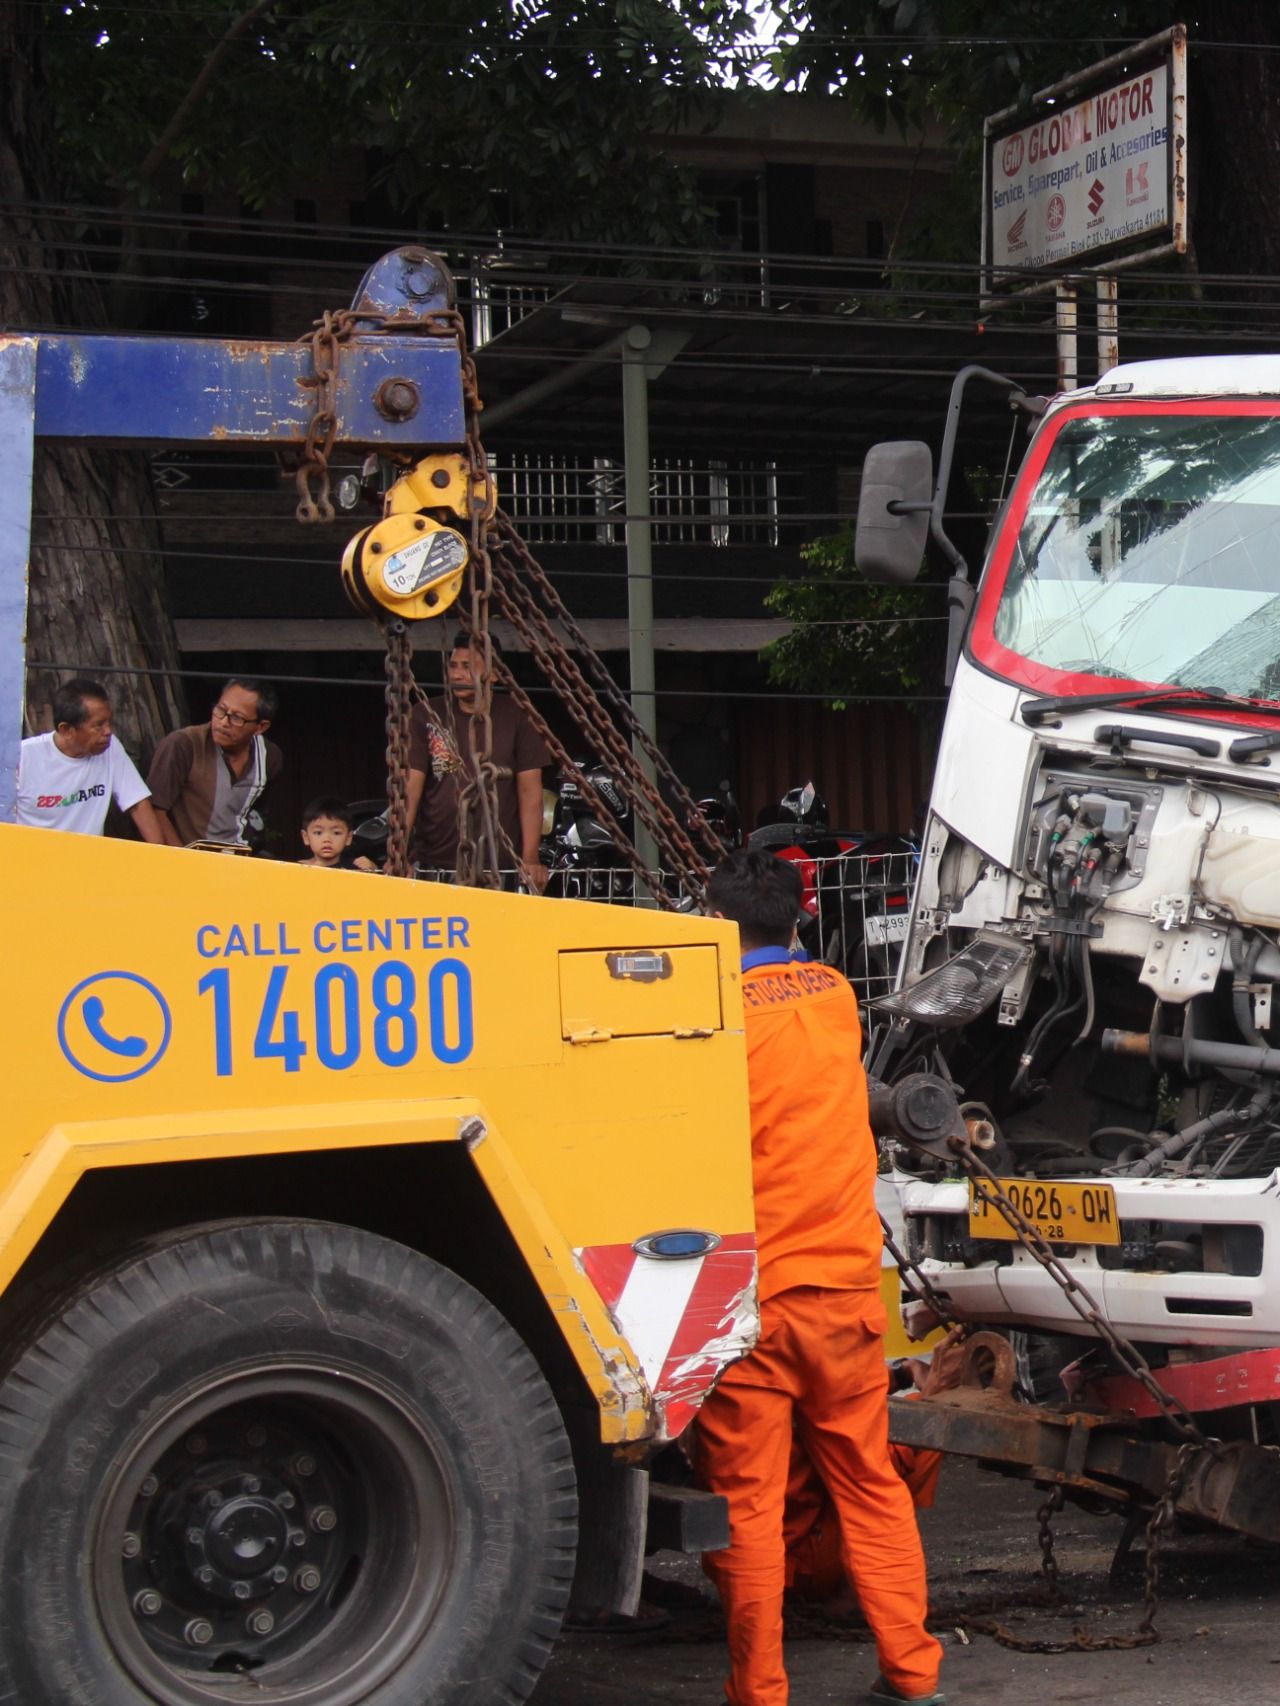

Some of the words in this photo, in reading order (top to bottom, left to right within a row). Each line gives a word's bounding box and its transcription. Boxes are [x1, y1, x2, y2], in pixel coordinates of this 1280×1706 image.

[1096, 77, 1154, 137] MOTOR
[1085, 150, 1098, 175] Oil
[1100, 147, 1107, 168] &
[1104, 218, 1144, 242] Purwakarta
[392, 574, 407, 589] 10
[196, 922, 301, 958] CALL
[313, 915, 471, 954] CENTER
[197, 957, 474, 1077] 14080
